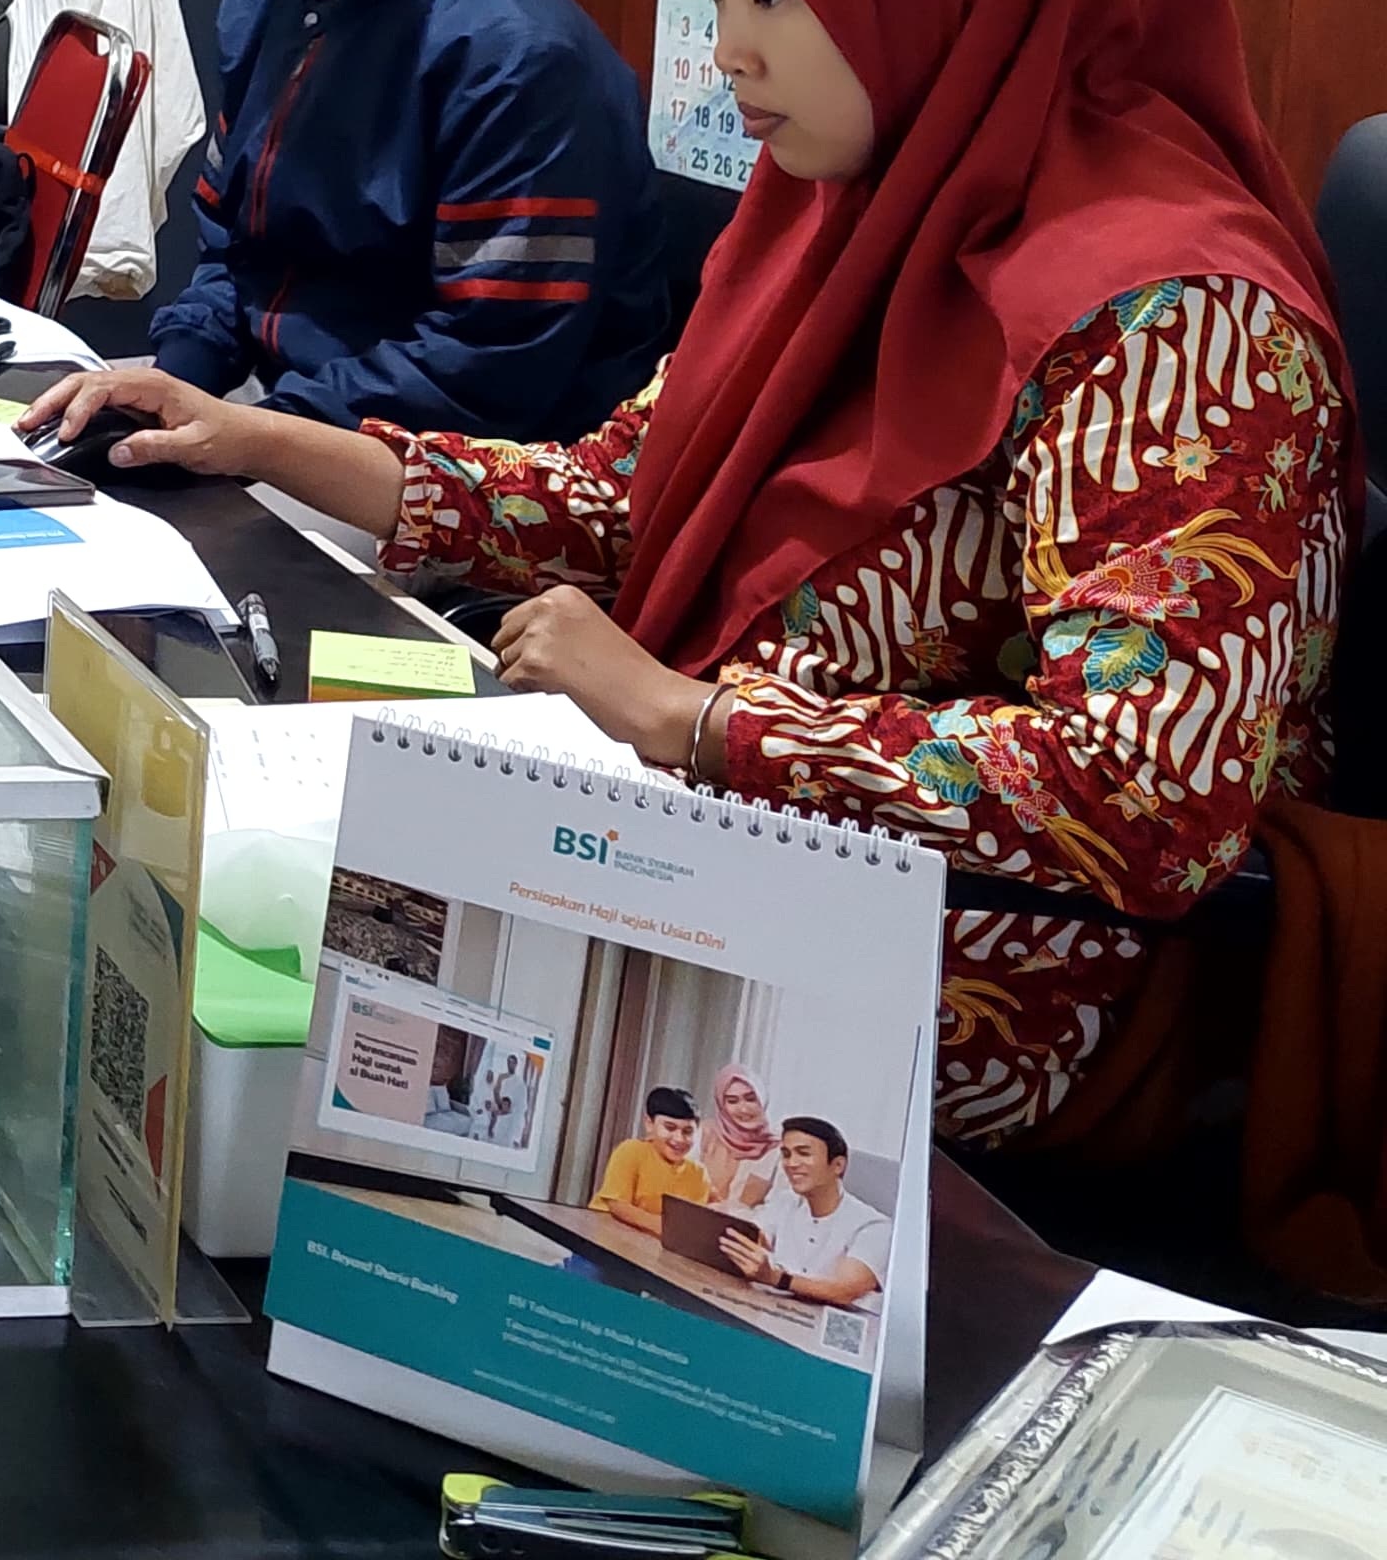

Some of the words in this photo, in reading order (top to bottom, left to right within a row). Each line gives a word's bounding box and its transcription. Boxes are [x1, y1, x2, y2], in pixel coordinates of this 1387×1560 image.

[681, 15, 690, 37] 3
[704, 20, 714, 43] 4
[674, 58, 690, 81] 10
[699, 62, 713, 87] 11
[671, 98, 686, 123] 17
[694, 104, 710, 128] 18
[718, 110, 735, 134] 19
[691, 147, 709, 171] 25
[714, 152, 732, 178] 26
[553, 825, 609, 865] BSI
[614, 860, 674, 883] INDONESIA
[509, 881, 586, 914] Persiapkan
[588, 903, 618, 924] Haji
[621, 913, 656, 934] sejak
[661, 921, 692, 942] Usia
[695, 931, 726, 951] Dini
[351, 1002, 373, 1017] BSI
[351, 1053, 373, 1067] Haji
[374, 1059, 402, 1076] untuk
[353, 1040, 418, 1066] Perencanaan
[349, 1066, 359, 1077] si
[360, 1069, 385, 1084] Buah
[386, 1076, 409, 1090] Hati
[411, 1277, 460, 1305] Banking
